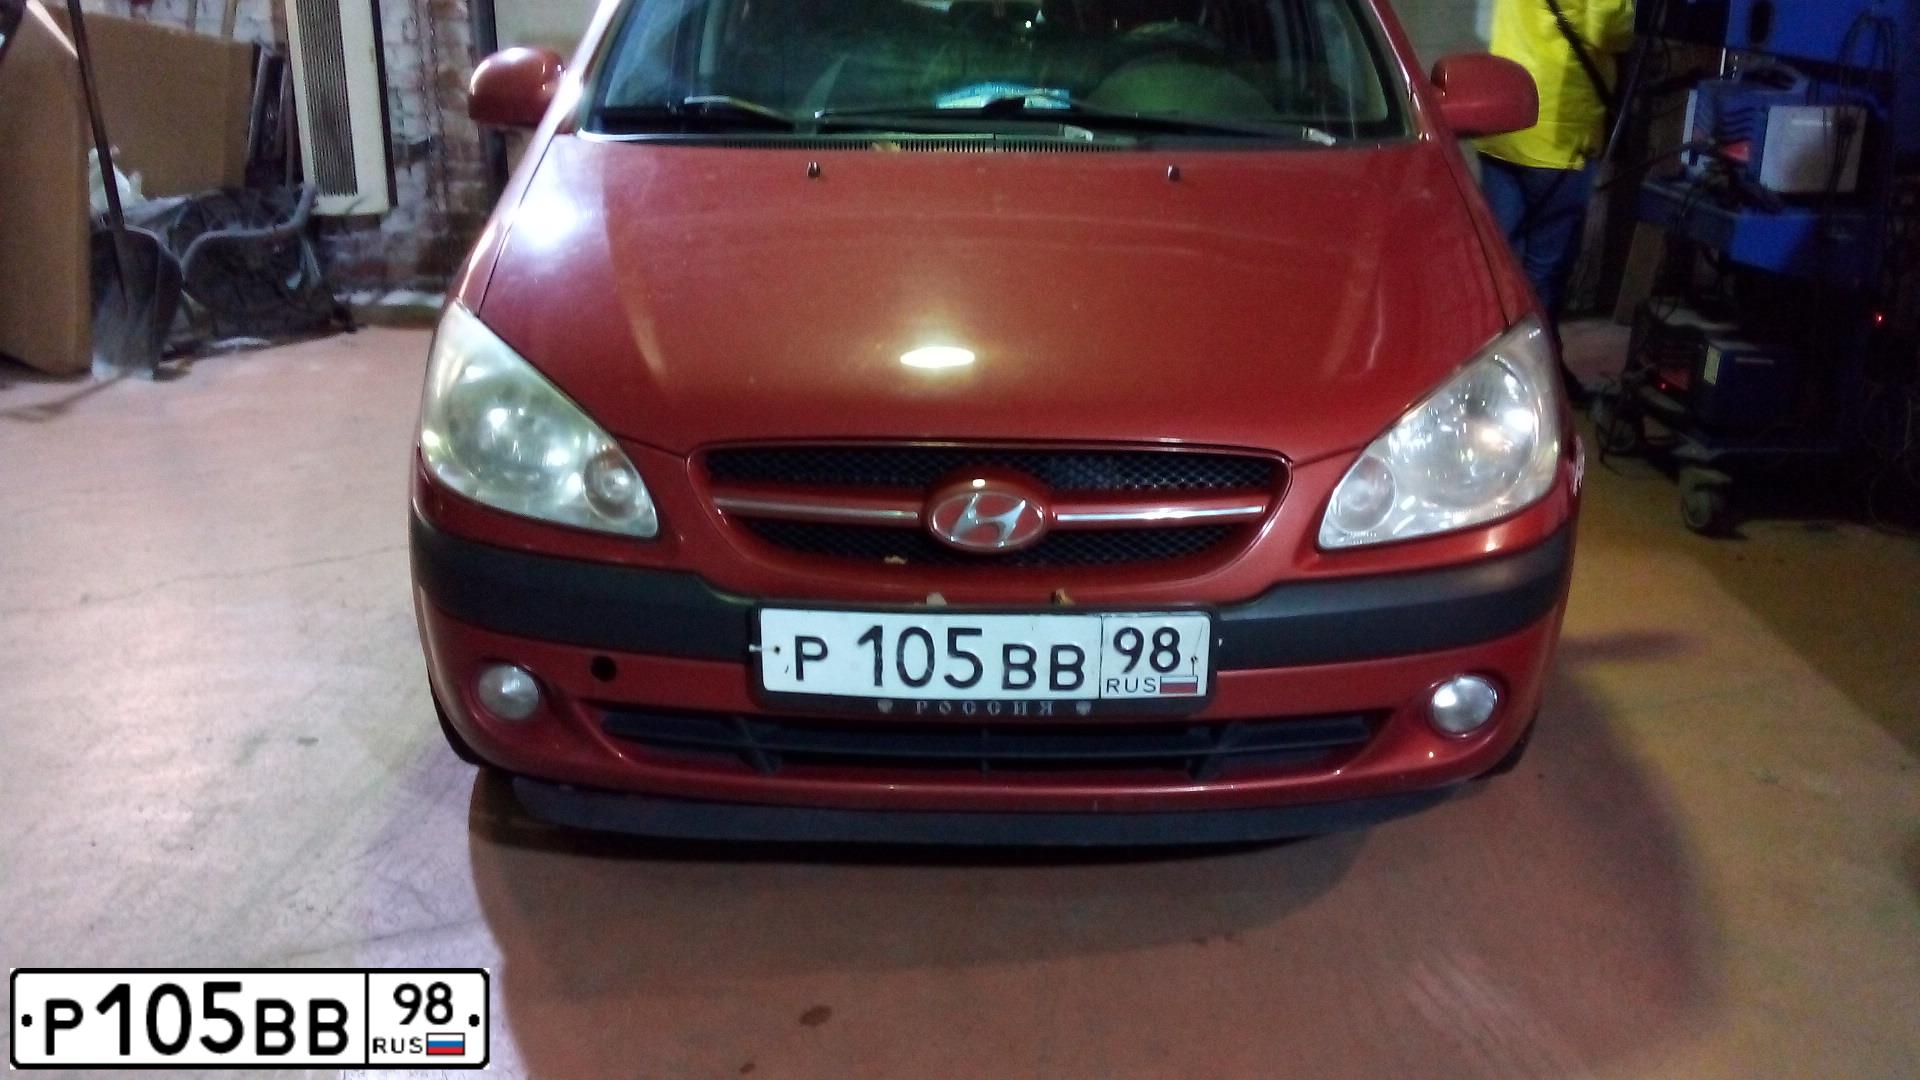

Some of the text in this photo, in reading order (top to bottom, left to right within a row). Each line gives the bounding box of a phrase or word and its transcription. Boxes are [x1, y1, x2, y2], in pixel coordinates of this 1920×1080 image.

[1112, 626, 1182, 674] 98
[1105, 677, 1156, 693] RUS
[915, 700, 1054, 716] РОССИЯ
